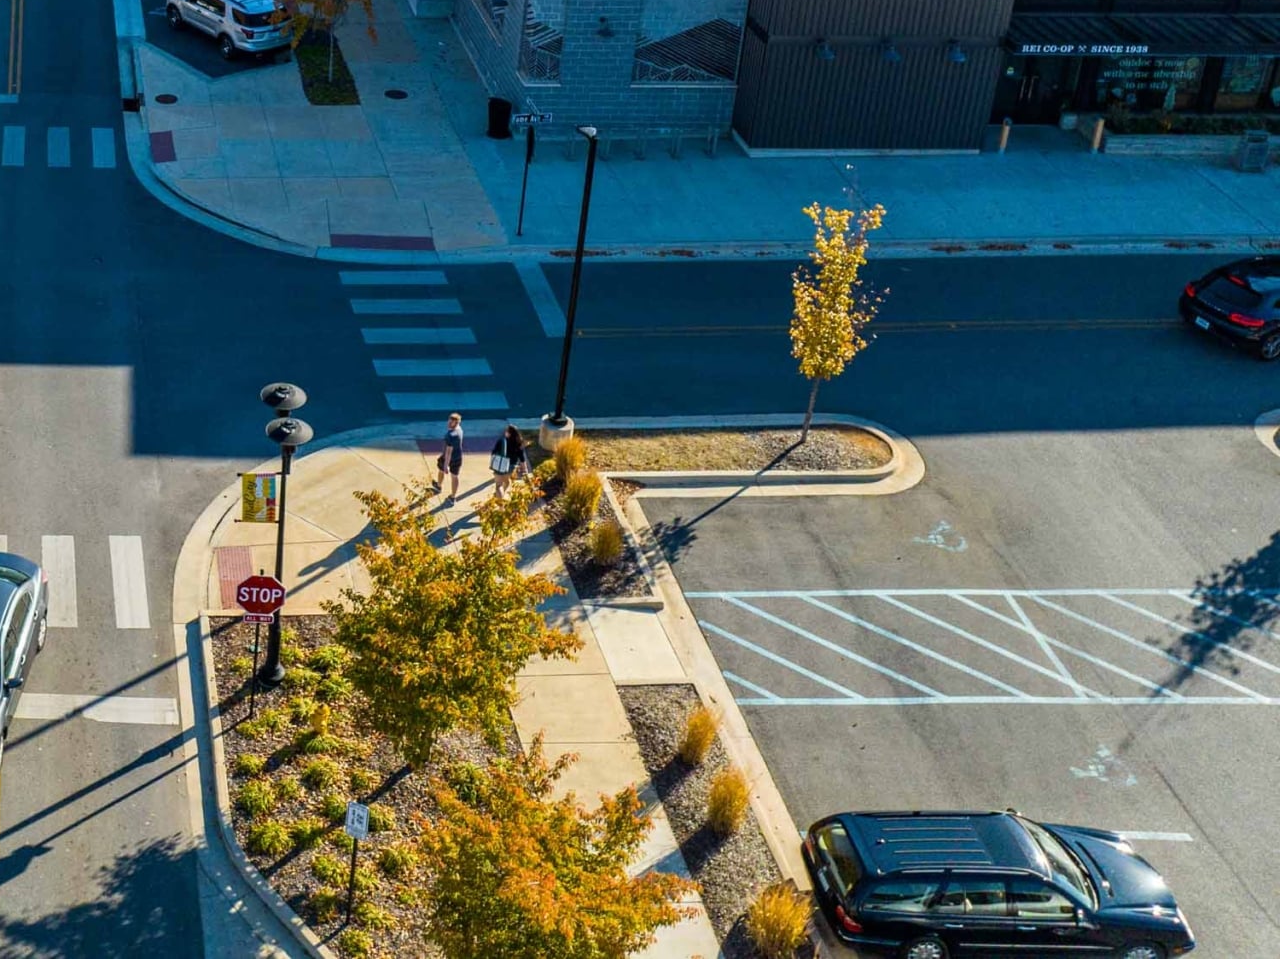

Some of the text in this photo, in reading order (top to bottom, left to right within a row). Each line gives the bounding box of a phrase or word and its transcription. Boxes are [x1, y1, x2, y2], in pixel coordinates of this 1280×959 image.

[1022, 45, 1041, 53] REI
[1090, 45, 1123, 53] SINCE
[1125, 45, 1149, 53] 1938
[238, 587, 282, 603] STOP
